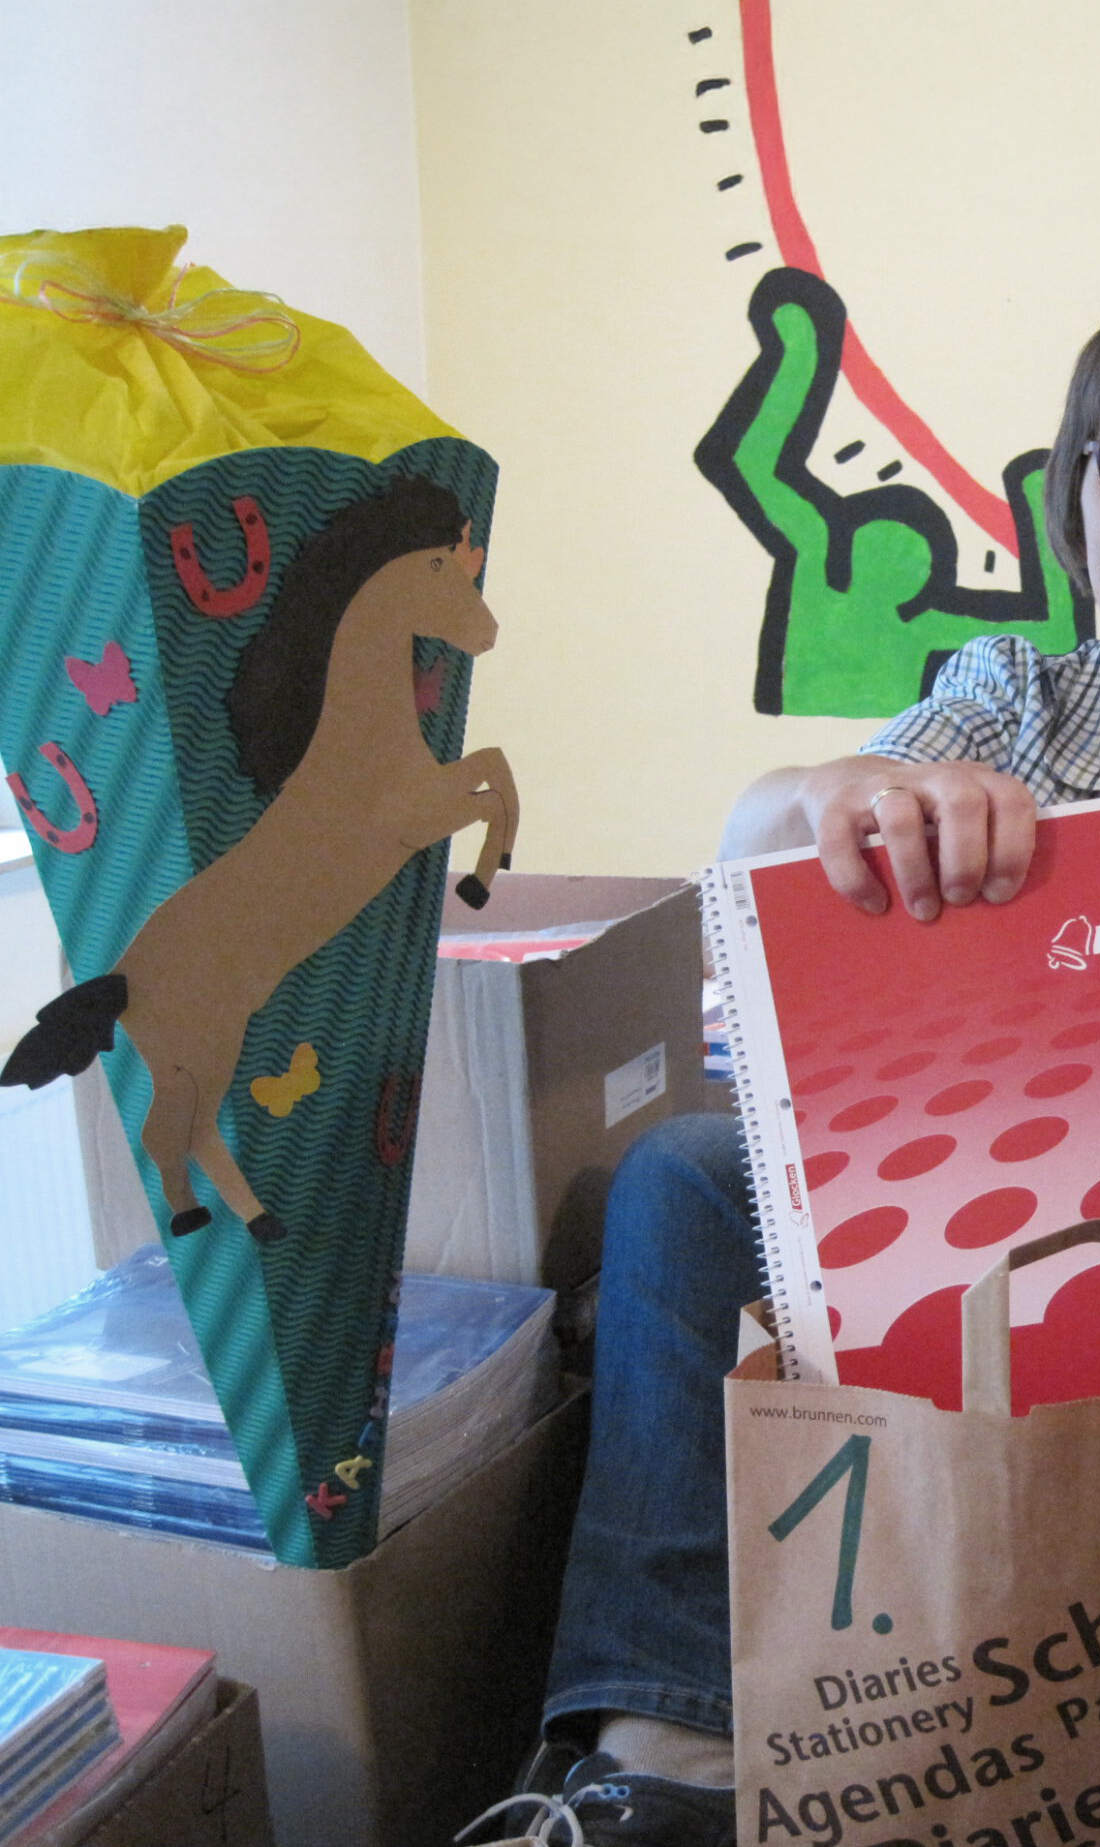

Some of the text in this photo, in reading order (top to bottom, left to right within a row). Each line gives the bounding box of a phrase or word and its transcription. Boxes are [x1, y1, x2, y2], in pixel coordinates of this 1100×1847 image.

[786, 1164, 802, 1207] Glocken
[750, 1406, 888, 1428] www.brunnen.com
[768, 1434, 894, 1635] 1.
[814, 1655, 962, 1711] Diaries
[767, 1697, 974, 1766] Stationery
[757, 1733, 1045, 1847] Agendas
